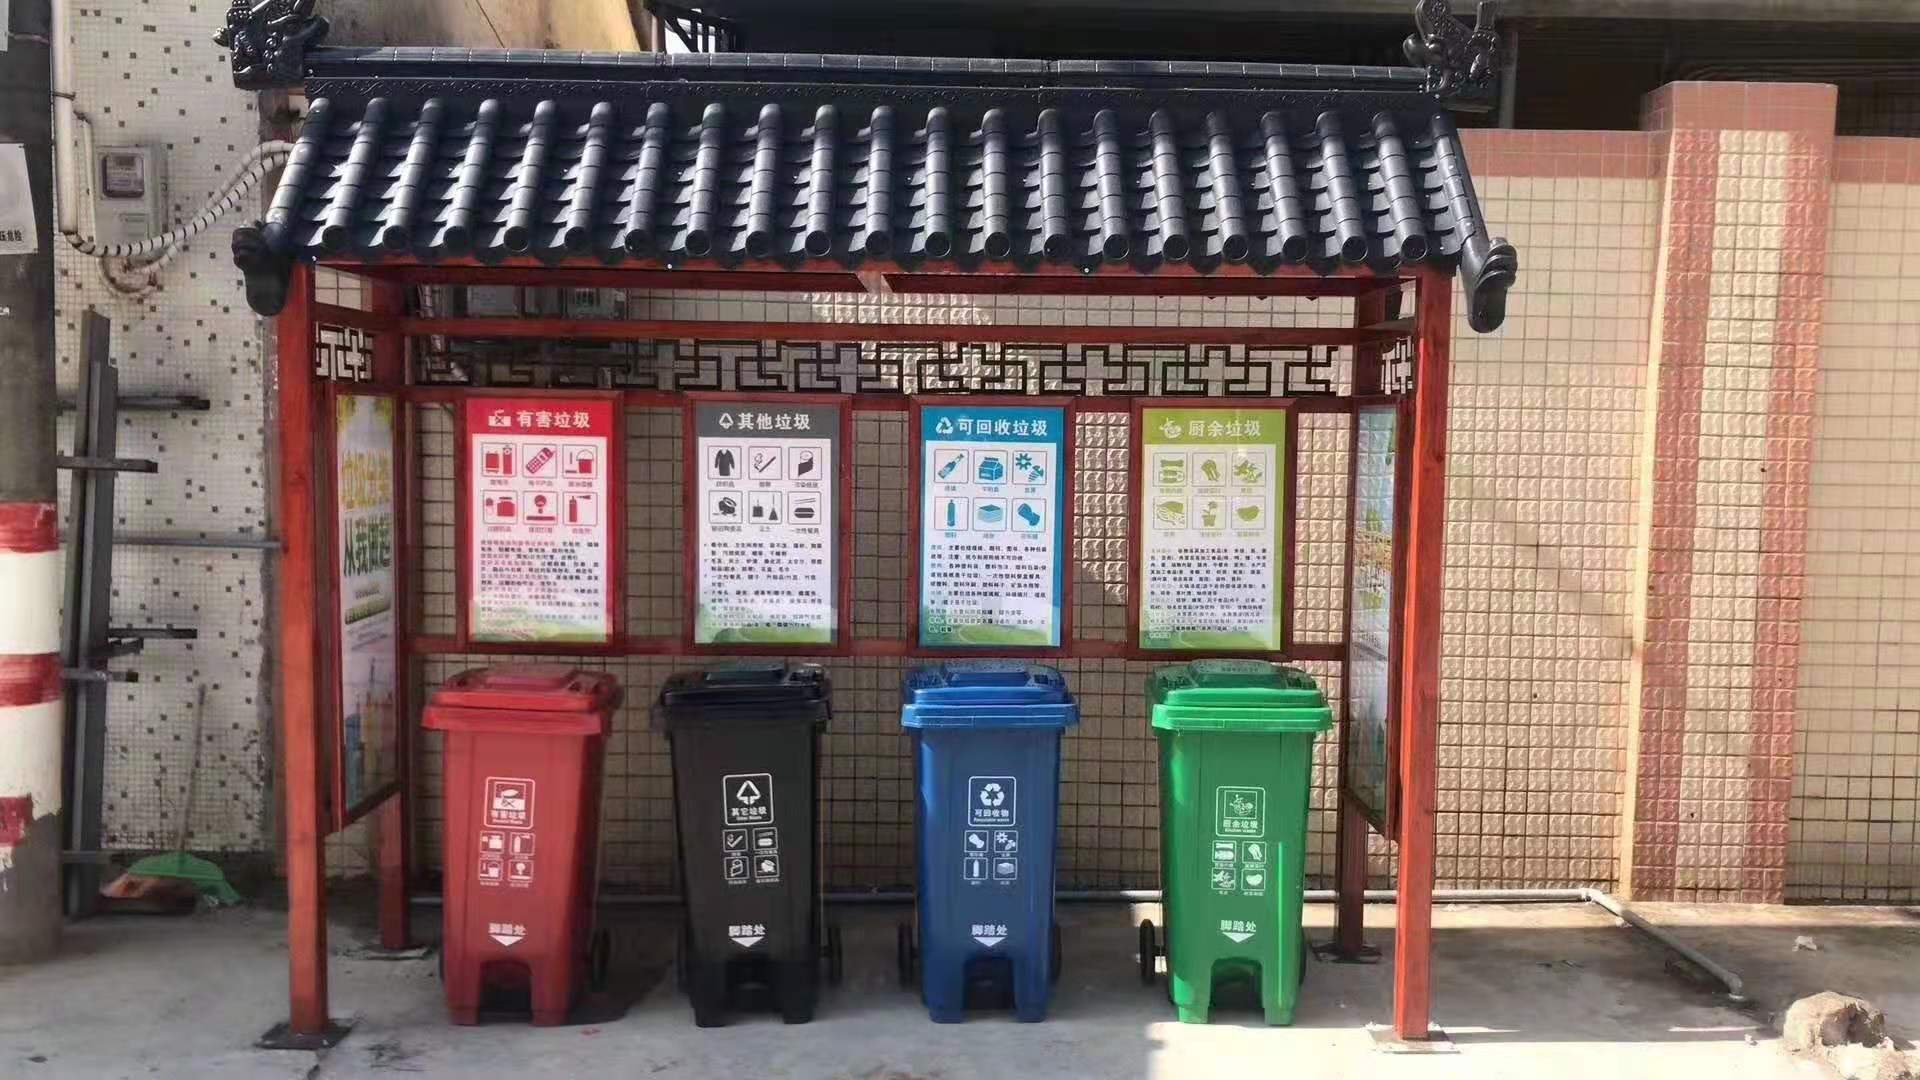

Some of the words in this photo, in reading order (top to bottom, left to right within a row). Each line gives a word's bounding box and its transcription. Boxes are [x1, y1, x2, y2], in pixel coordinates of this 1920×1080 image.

[516, 409, 591, 429] 有害垃圾
[737, 412, 811, 430] 其他垃圾
[957, 418, 1048, 437] 可回收垃圾
[1188, 419, 1262, 438] 厨余垃圾
[731, 805, 768, 817] 其它垃圾
[974, 808, 1010, 818] 可回收物
[488, 922, 527, 936] 脚踏处
[728, 923, 766, 937] 脚踏处
[971, 923, 1009, 937] 脚踏处
[1220, 919, 1257, 933] 脚踏处
